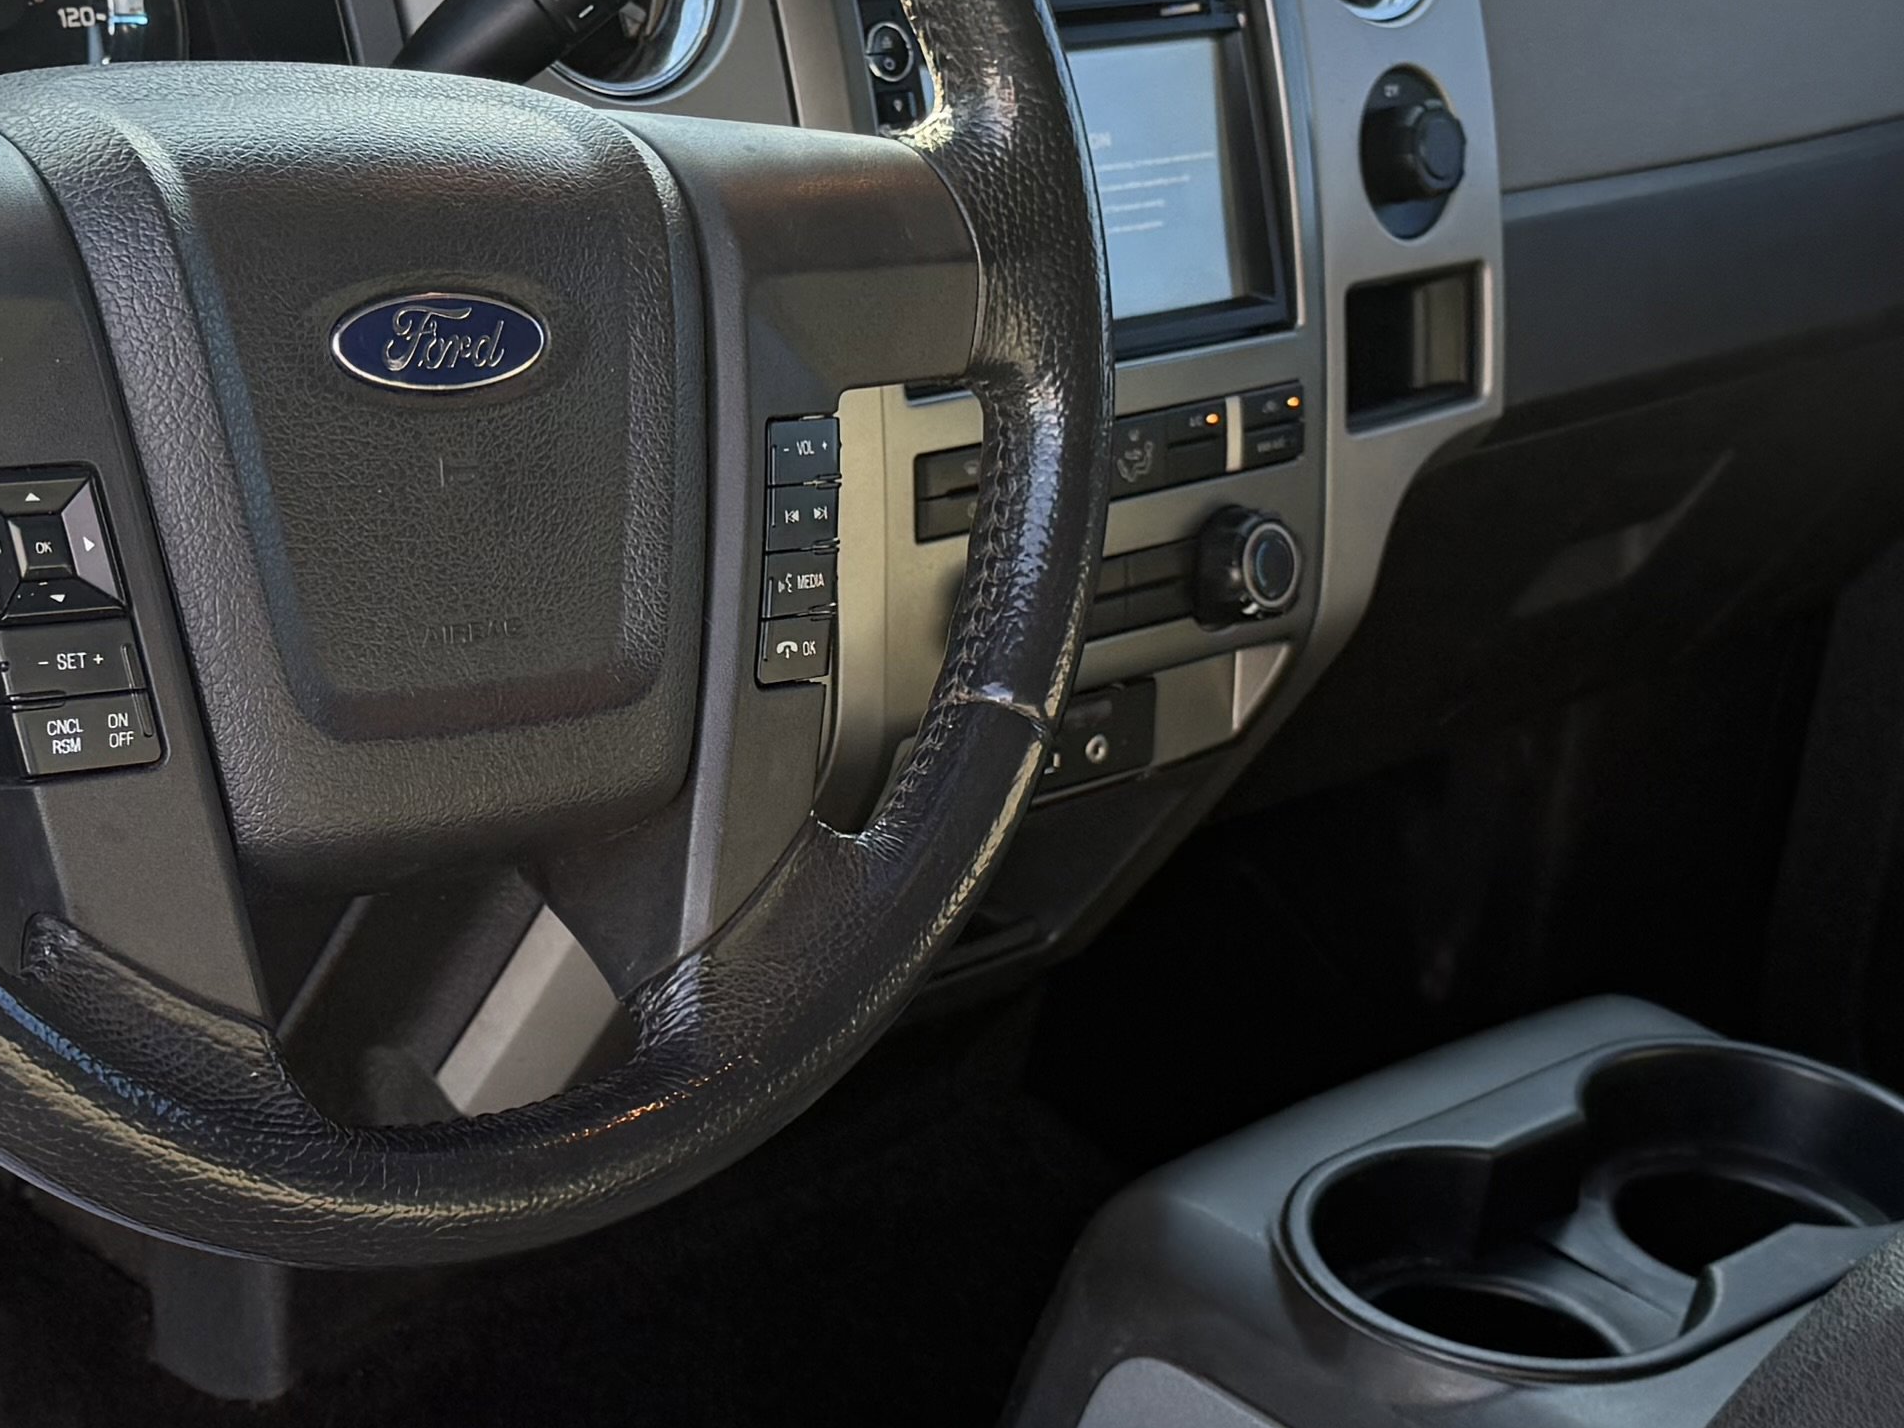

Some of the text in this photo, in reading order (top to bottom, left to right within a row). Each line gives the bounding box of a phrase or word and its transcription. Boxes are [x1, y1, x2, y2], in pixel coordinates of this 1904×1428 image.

[57, 6, 96, 28] 120
[381, 305, 505, 371] Ford
[797, 440, 814, 456] VOL
[36, 541, 53, 554] OK
[797, 573, 824, 590] MEDIA
[802, 640, 816, 656] OK
[57, 652, 87, 670] SET
[47, 718, 83, 736] CNCL
[108, 713, 128, 729] ON
[53, 738, 81, 755] RSM
[109, 731, 134, 748] OFF
